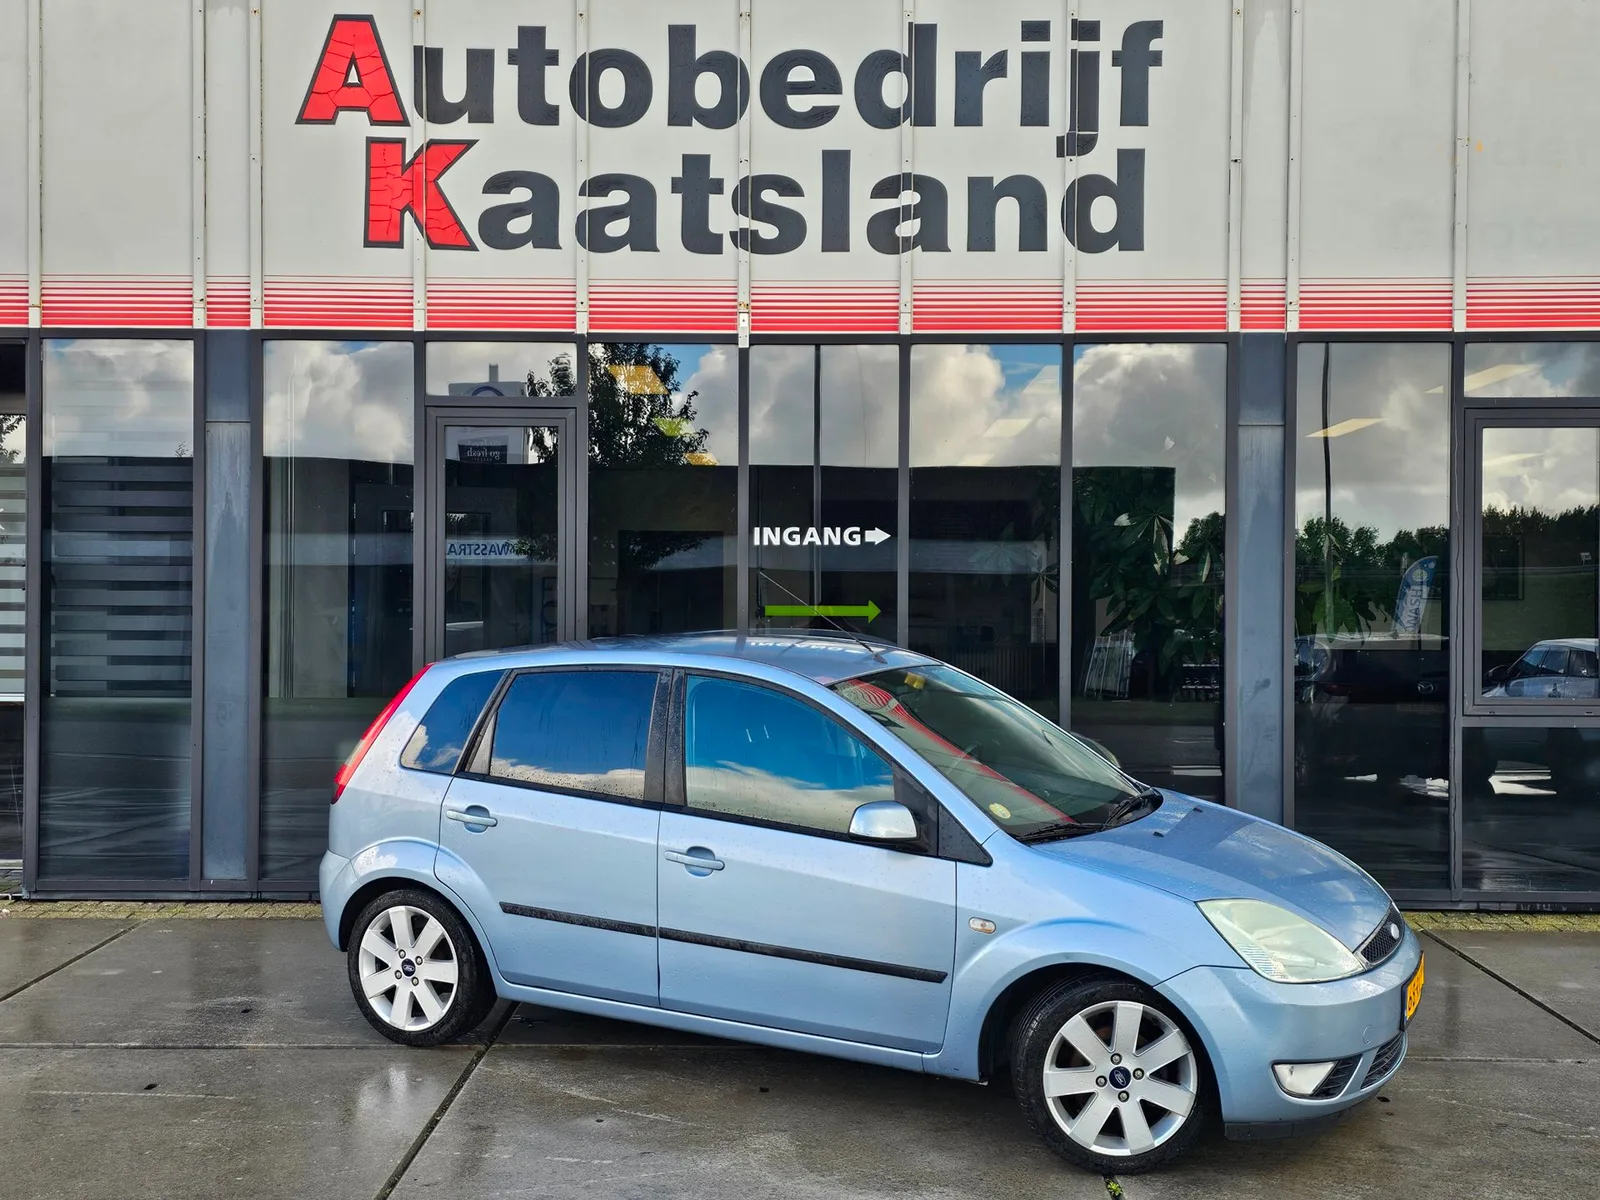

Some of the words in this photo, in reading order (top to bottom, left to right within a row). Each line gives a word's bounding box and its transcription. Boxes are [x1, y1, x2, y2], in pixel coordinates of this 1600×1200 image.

[295, 14, 1163, 157] Autobedrijf
[363, 136, 1145, 255] Kaatsland
[753, 526, 861, 546] INGANG
